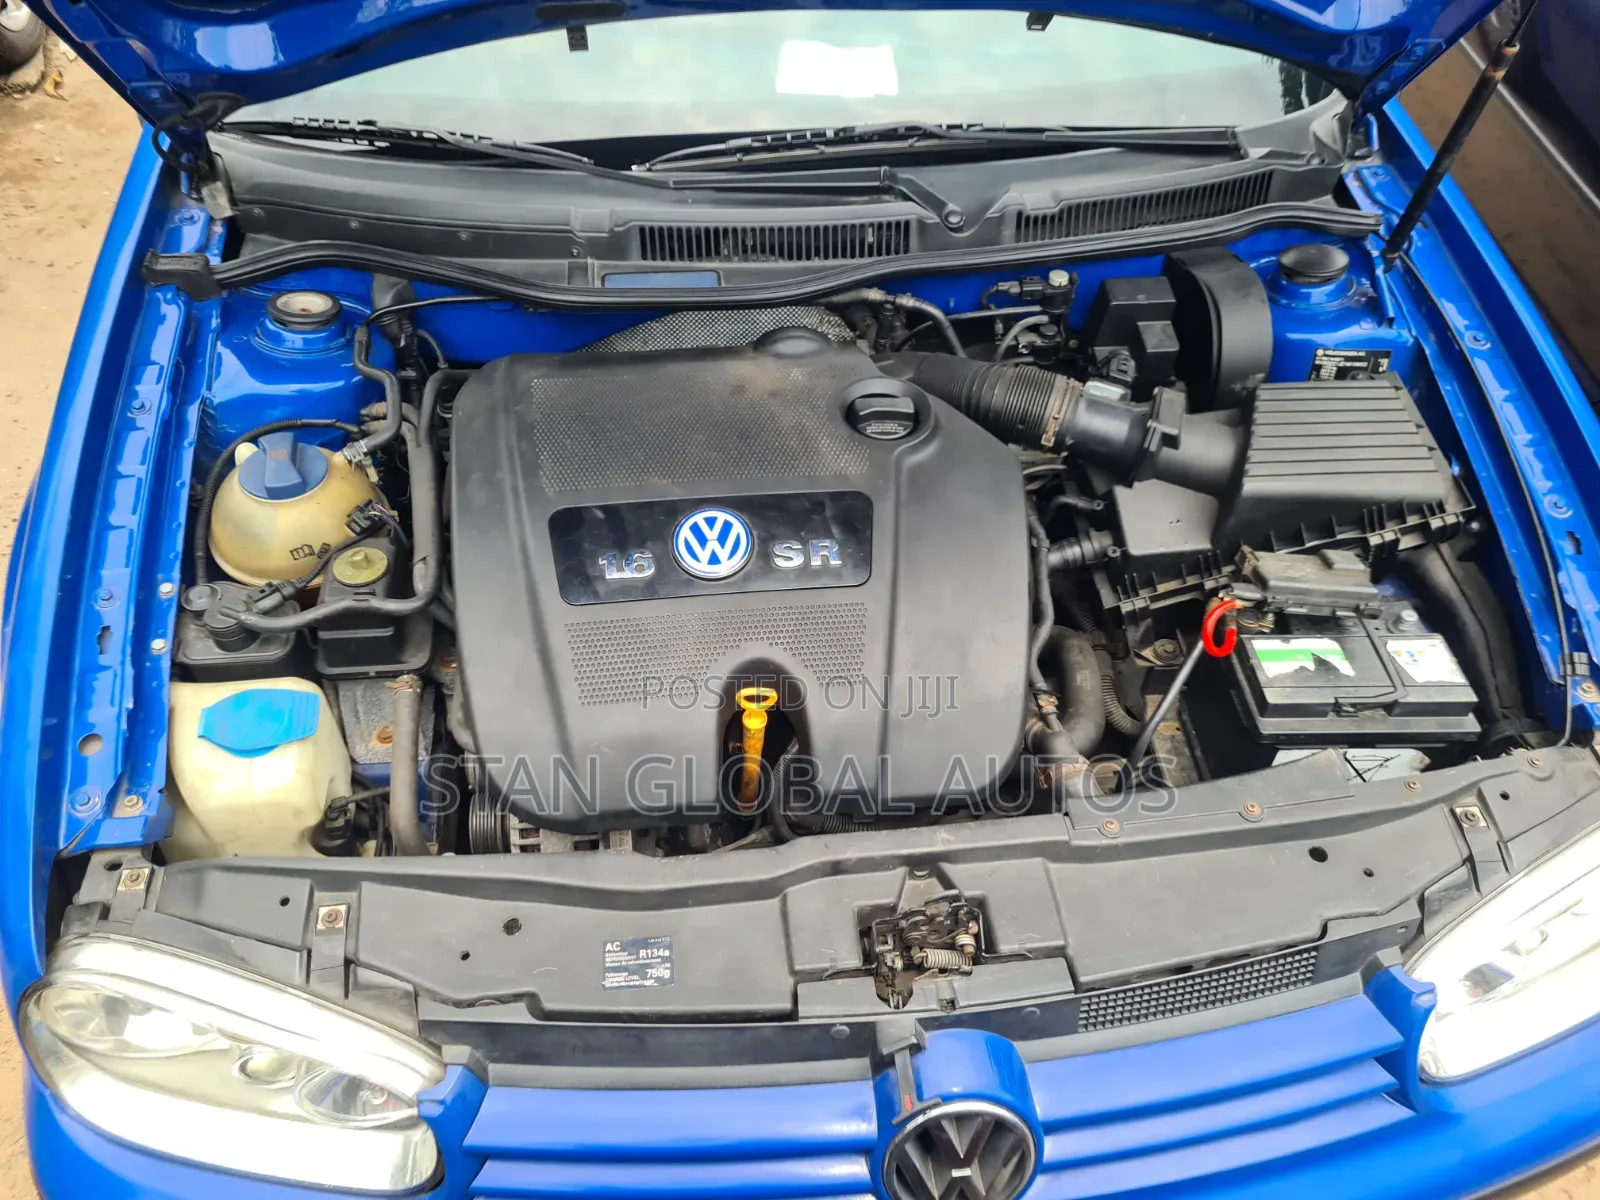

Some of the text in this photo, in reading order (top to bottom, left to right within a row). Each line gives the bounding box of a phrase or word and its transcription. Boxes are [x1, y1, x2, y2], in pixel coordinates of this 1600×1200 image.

[772, 538, 842, 568] SR
[605, 942, 621, 952] AC
[640, 948, 670, 958] R134a
[645, 968, 671, 979] 750g
